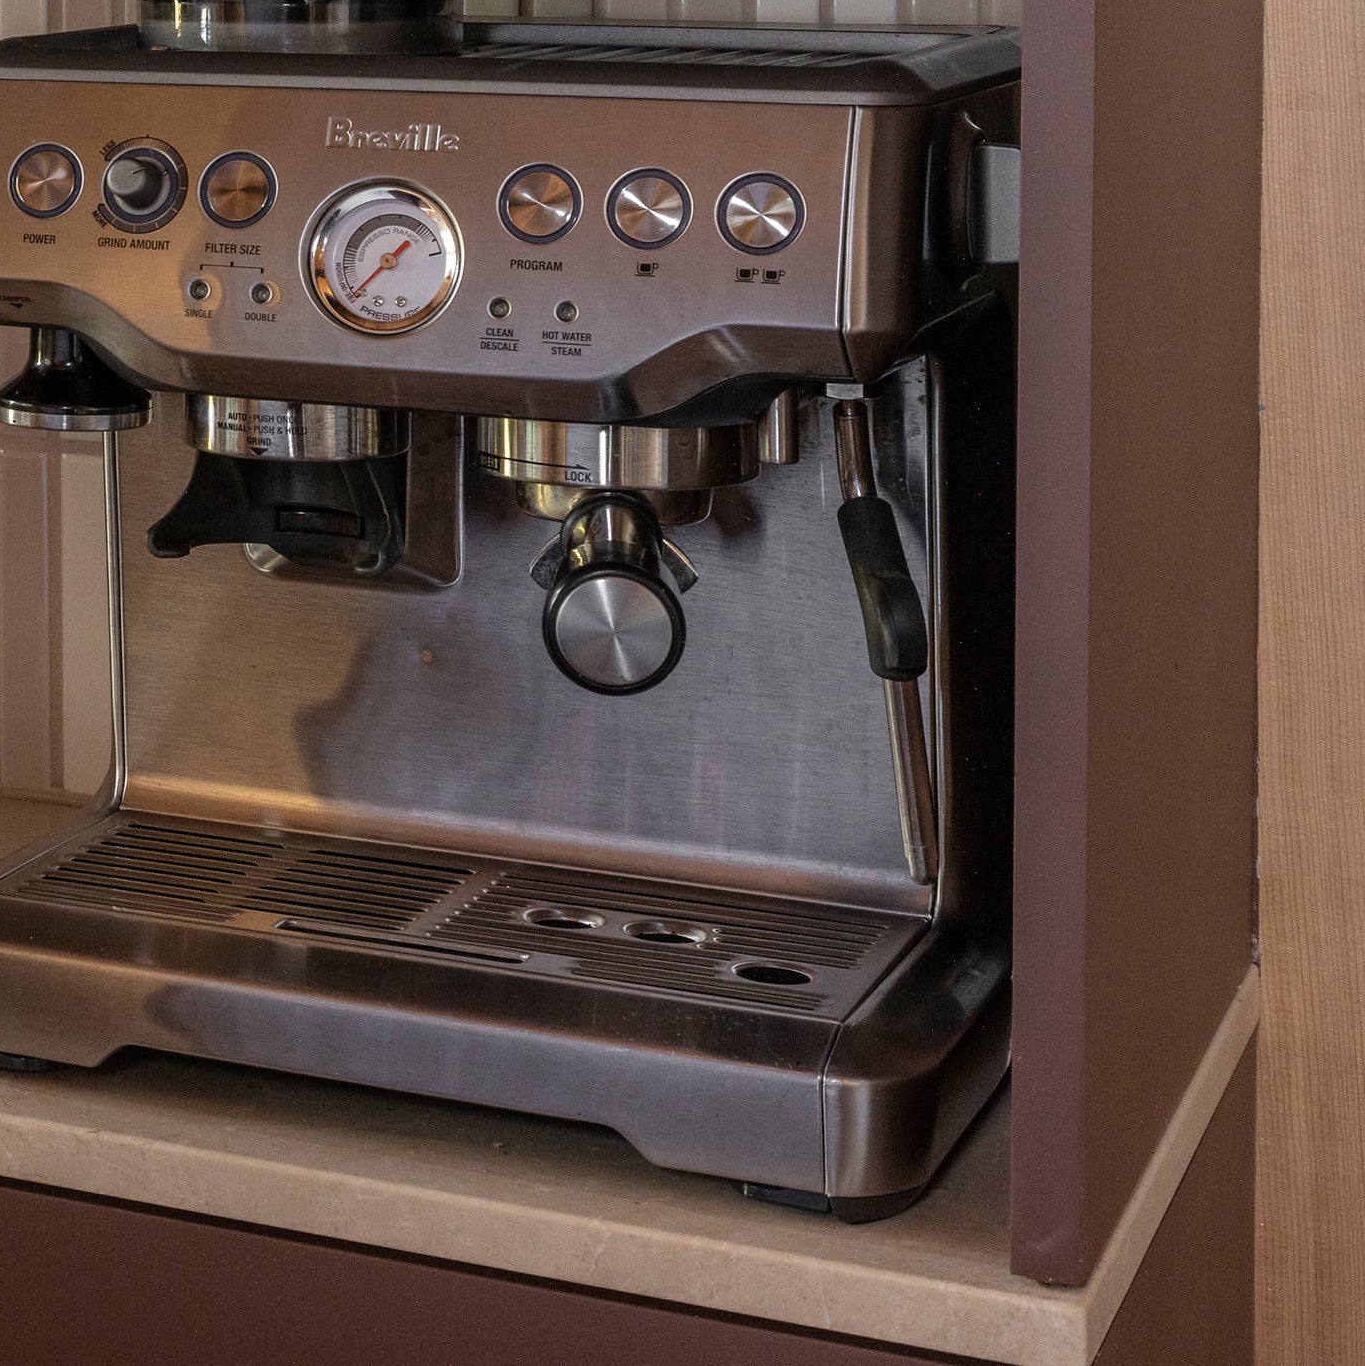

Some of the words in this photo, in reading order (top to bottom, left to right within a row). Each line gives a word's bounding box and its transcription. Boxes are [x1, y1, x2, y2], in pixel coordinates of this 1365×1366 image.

[325, 115, 460, 152] Breville
[99, 139, 117, 156] LESS
[91, 209, 109, 230] MORE
[23, 233, 57, 246] POWER
[97, 236, 127, 249] GRIND
[129, 238, 171, 251] AMOUNT
[357, 227, 391, 263] ESPRESSO
[392, 227, 422, 245] RANGE
[205, 242, 237, 255] FILTER
[240, 243, 262, 256] SIZE
[510, 259, 563, 272] PROGRAM
[184, 308, 213, 319] SINGLE
[244, 311, 277, 323] DOUBLE
[485, 327, 514, 338] CLEAN
[542, 330, 559, 340] HOT
[561, 331, 592, 342] WATER
[480, 340, 519, 352] DESCALE
[551, 346, 582, 357] STEAM
[228, 412, 247, 421] AUTO
[253, 414, 274, 423] PUSH
[217, 421, 247, 433] MANUAL
[253, 424, 275, 435] PUSH
[277, 426, 283, 435] &
[247, 436, 272, 446] GRIND
[565, 471, 592, 483] LOCK
